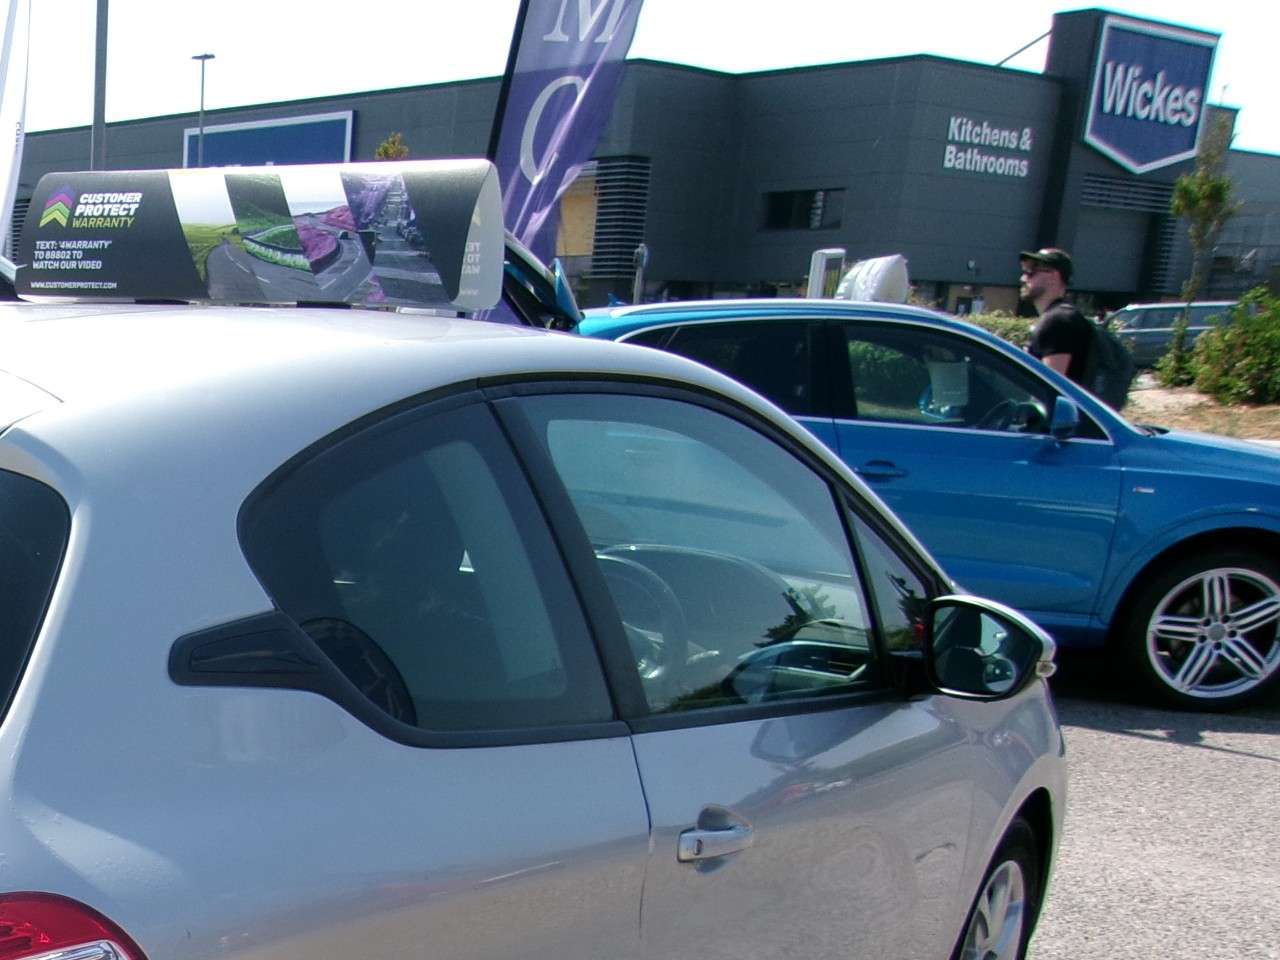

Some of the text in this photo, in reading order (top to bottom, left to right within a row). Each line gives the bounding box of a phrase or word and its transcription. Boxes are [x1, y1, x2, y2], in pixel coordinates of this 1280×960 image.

[1102, 61, 1200, 127] Wickes
[948, 116, 1032, 151] Kitchens &
[943, 145, 1029, 177] Bathrooms
[79, 192, 142, 204] CUSTOMER
[74, 203, 139, 216] PROTECT
[72, 217, 135, 229] WARRANTY
[35, 241, 57, 250] TEXT:
[34, 251, 44, 260] TO
[72, 251, 83, 260] TO
[32, 261, 102, 270] WATCH OUR VIDEO
